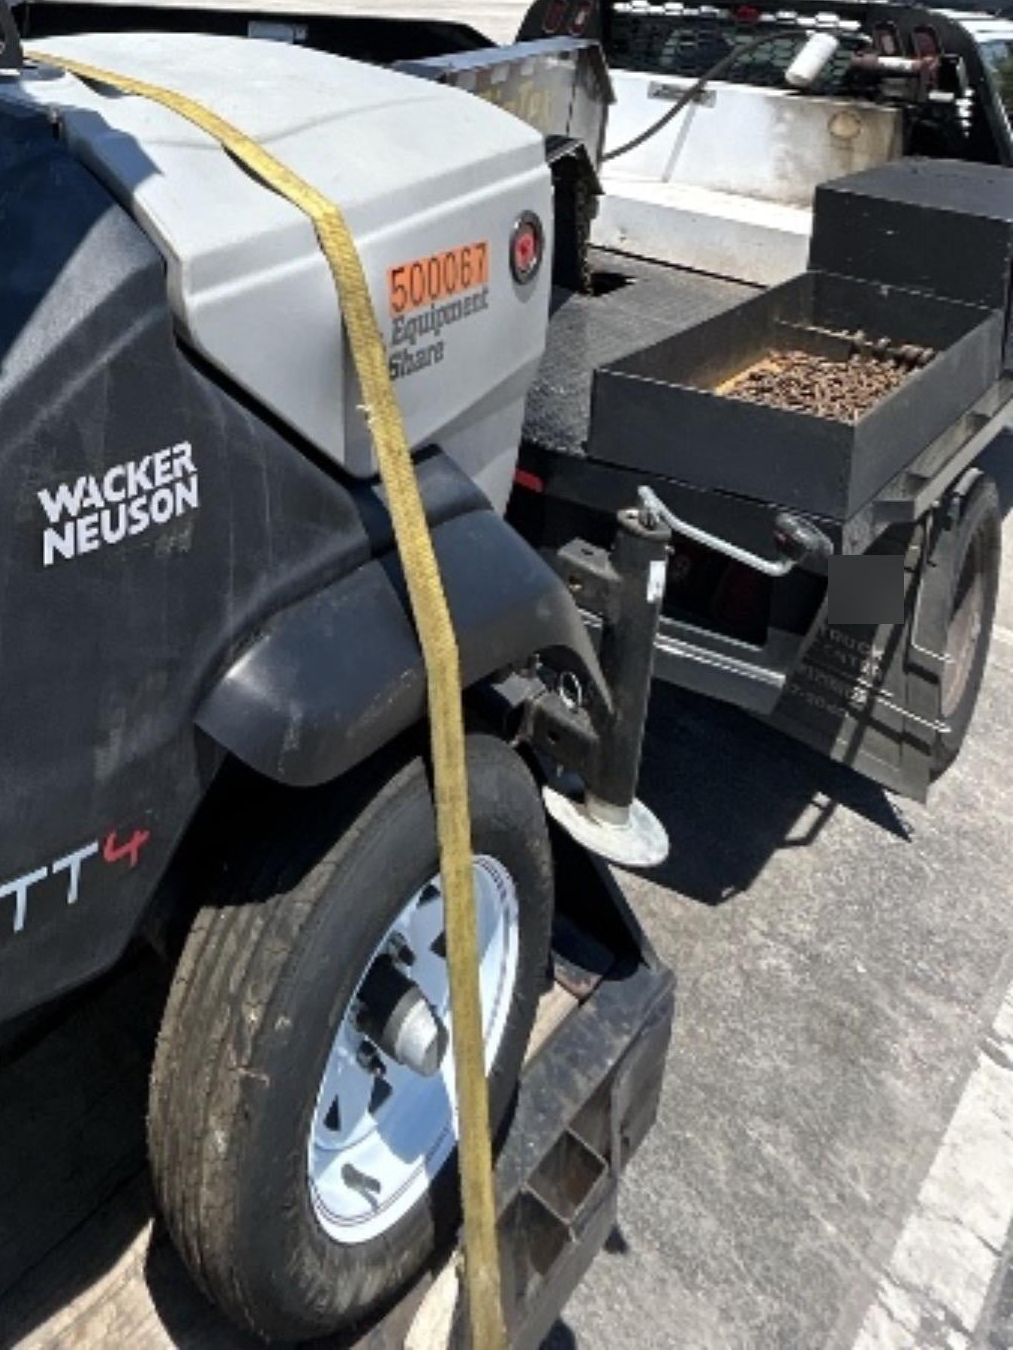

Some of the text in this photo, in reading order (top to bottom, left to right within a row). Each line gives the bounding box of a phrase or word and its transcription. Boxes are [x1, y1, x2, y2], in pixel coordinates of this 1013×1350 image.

[390, 242, 488, 312] 500067
[391, 286, 489, 345] Equipment
[388, 340, 445, 381] Share
[37, 440, 198, 523] WACKER
[43, 474, 200, 566] NEUSON
